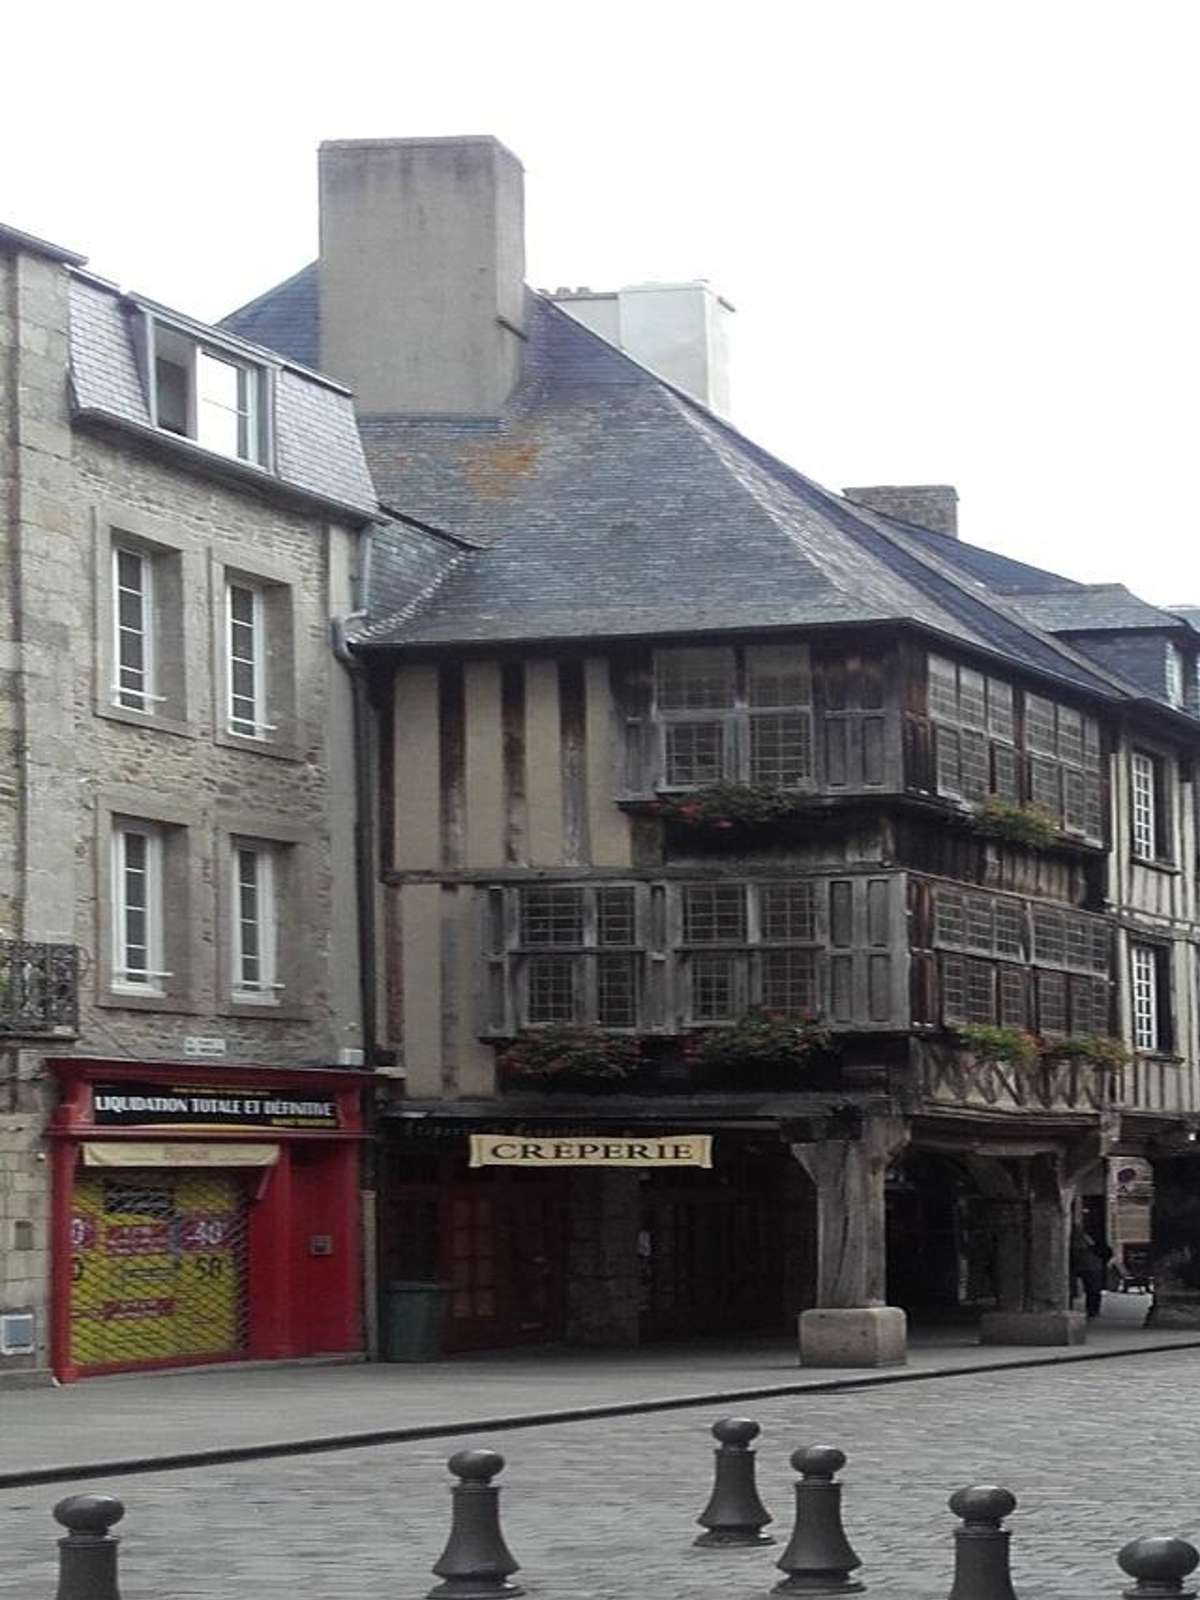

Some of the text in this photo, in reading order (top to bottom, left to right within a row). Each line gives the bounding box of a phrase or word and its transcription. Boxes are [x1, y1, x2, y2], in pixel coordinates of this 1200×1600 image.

[95, 1096, 187, 1113] LIQUIDATION
[191, 1098, 242, 1115] TOTALE
[244, 1099, 261, 1115] ET
